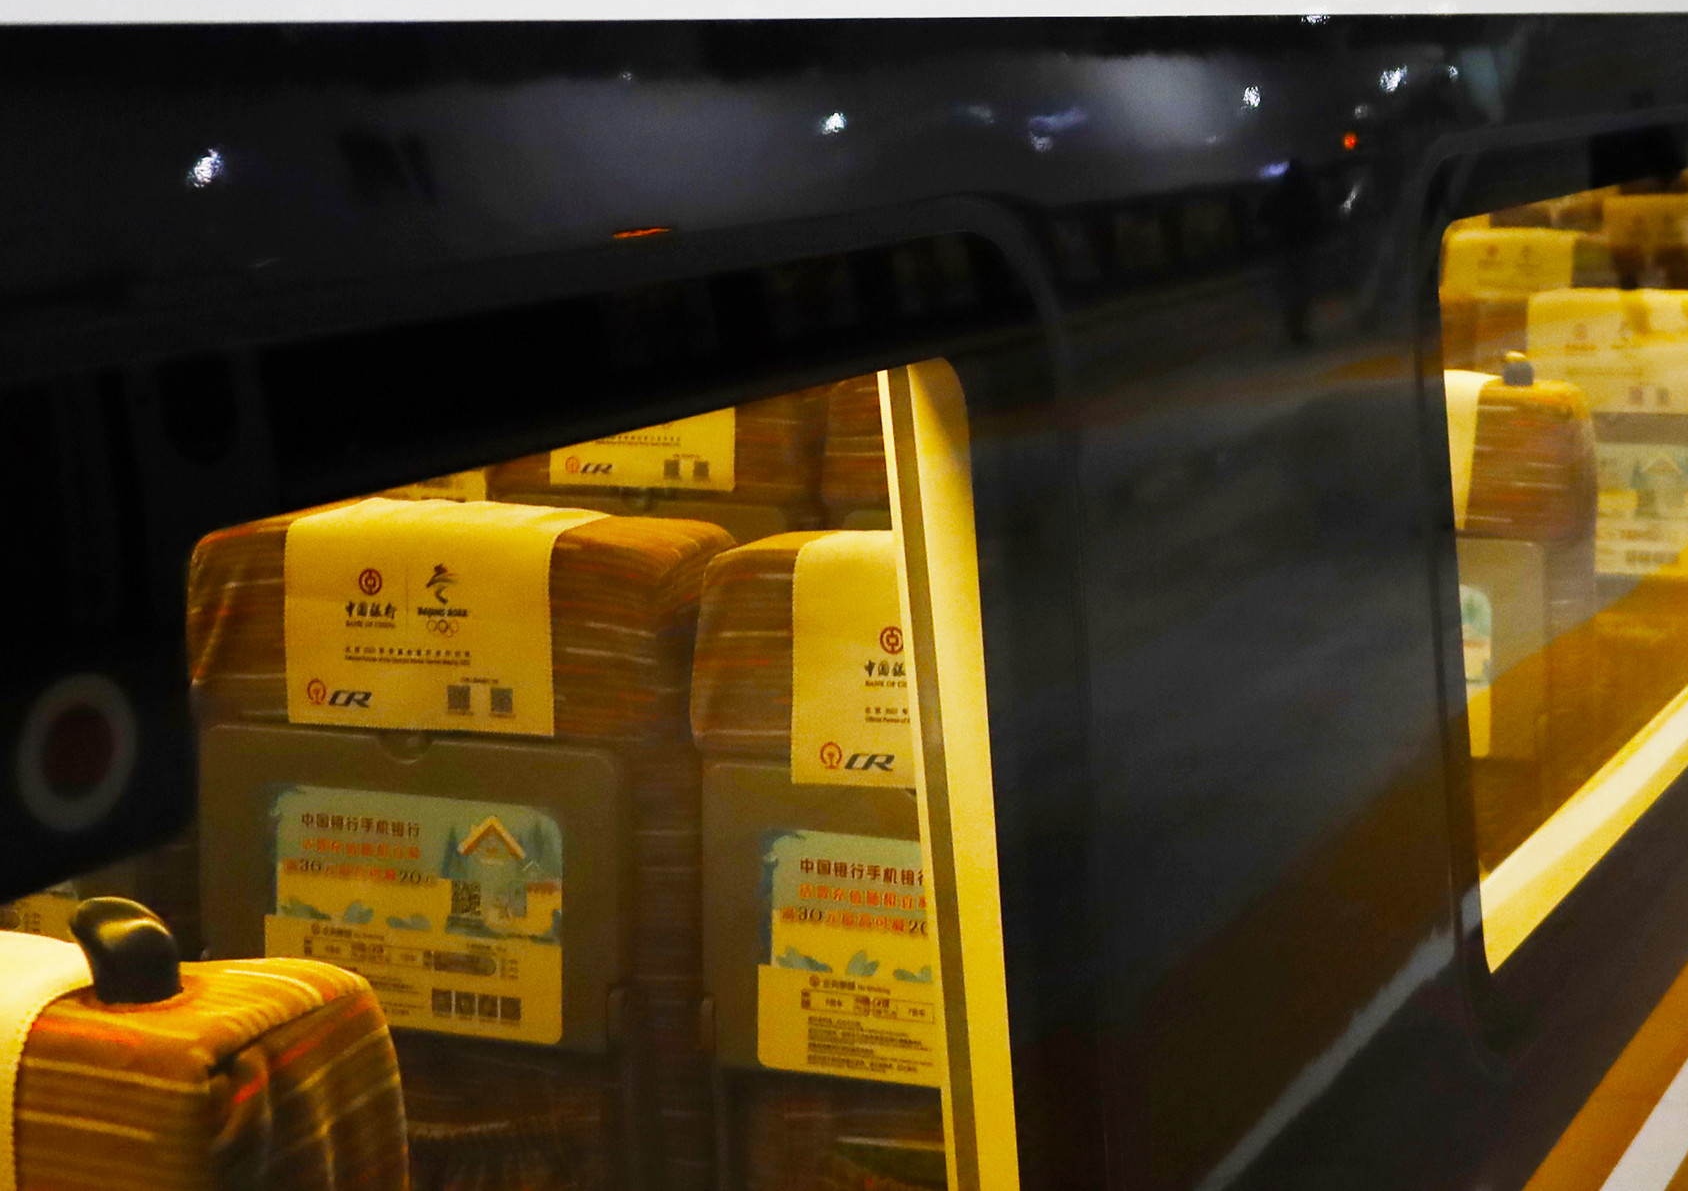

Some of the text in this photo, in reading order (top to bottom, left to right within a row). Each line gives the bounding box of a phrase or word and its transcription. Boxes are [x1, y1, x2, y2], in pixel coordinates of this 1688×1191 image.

[864, 659, 907, 677] 中国银
[328, 689, 373, 708] CR
[844, 752, 896, 772] CR
